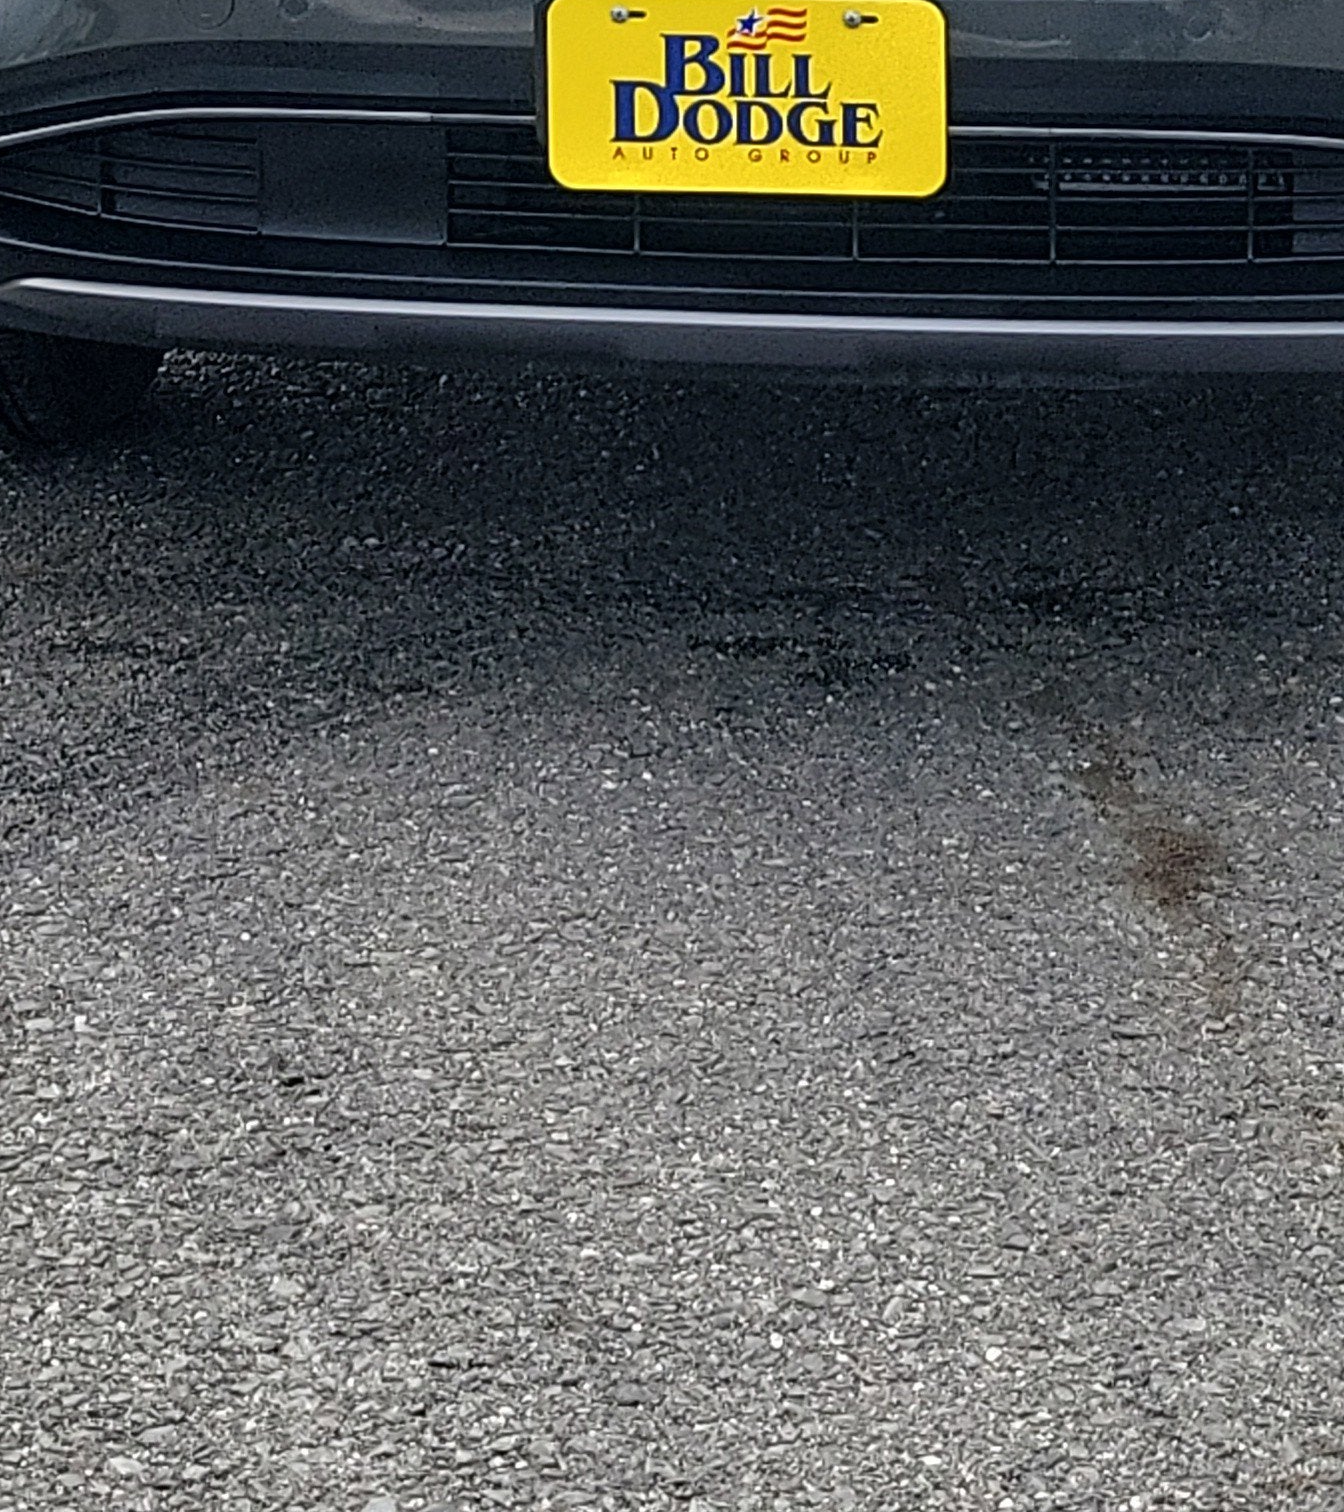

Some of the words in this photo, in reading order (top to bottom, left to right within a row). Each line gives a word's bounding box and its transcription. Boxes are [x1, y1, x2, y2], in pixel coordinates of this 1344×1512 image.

[660, 33, 833, 99] BILL
[609, 79, 884, 148] DODGE
[611, 146, 711, 163] AUTO
[748, 149, 879, 165] GROUP
